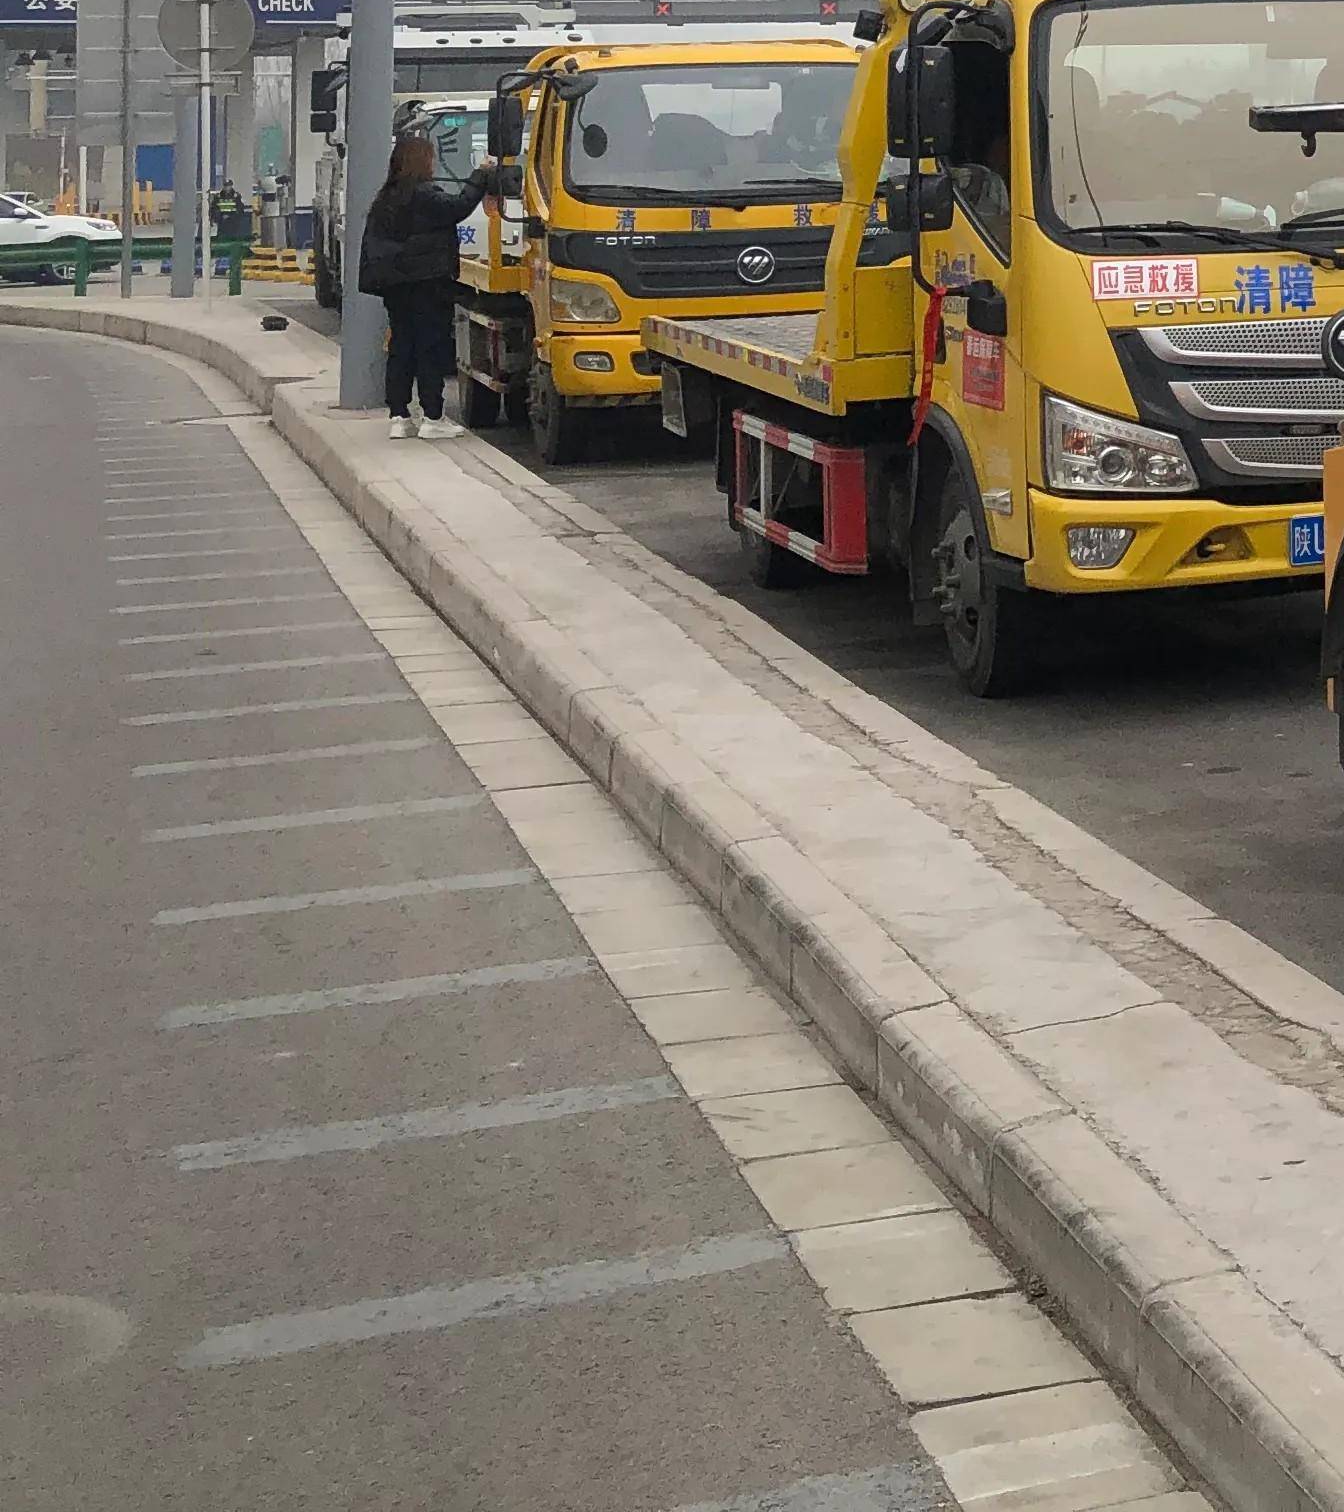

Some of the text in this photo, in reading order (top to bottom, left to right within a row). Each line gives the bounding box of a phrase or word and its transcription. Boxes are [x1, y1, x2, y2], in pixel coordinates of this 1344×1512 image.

[1096, 262, 1195, 295] 应急救援
[1133, 297, 1238, 317] FOTON
